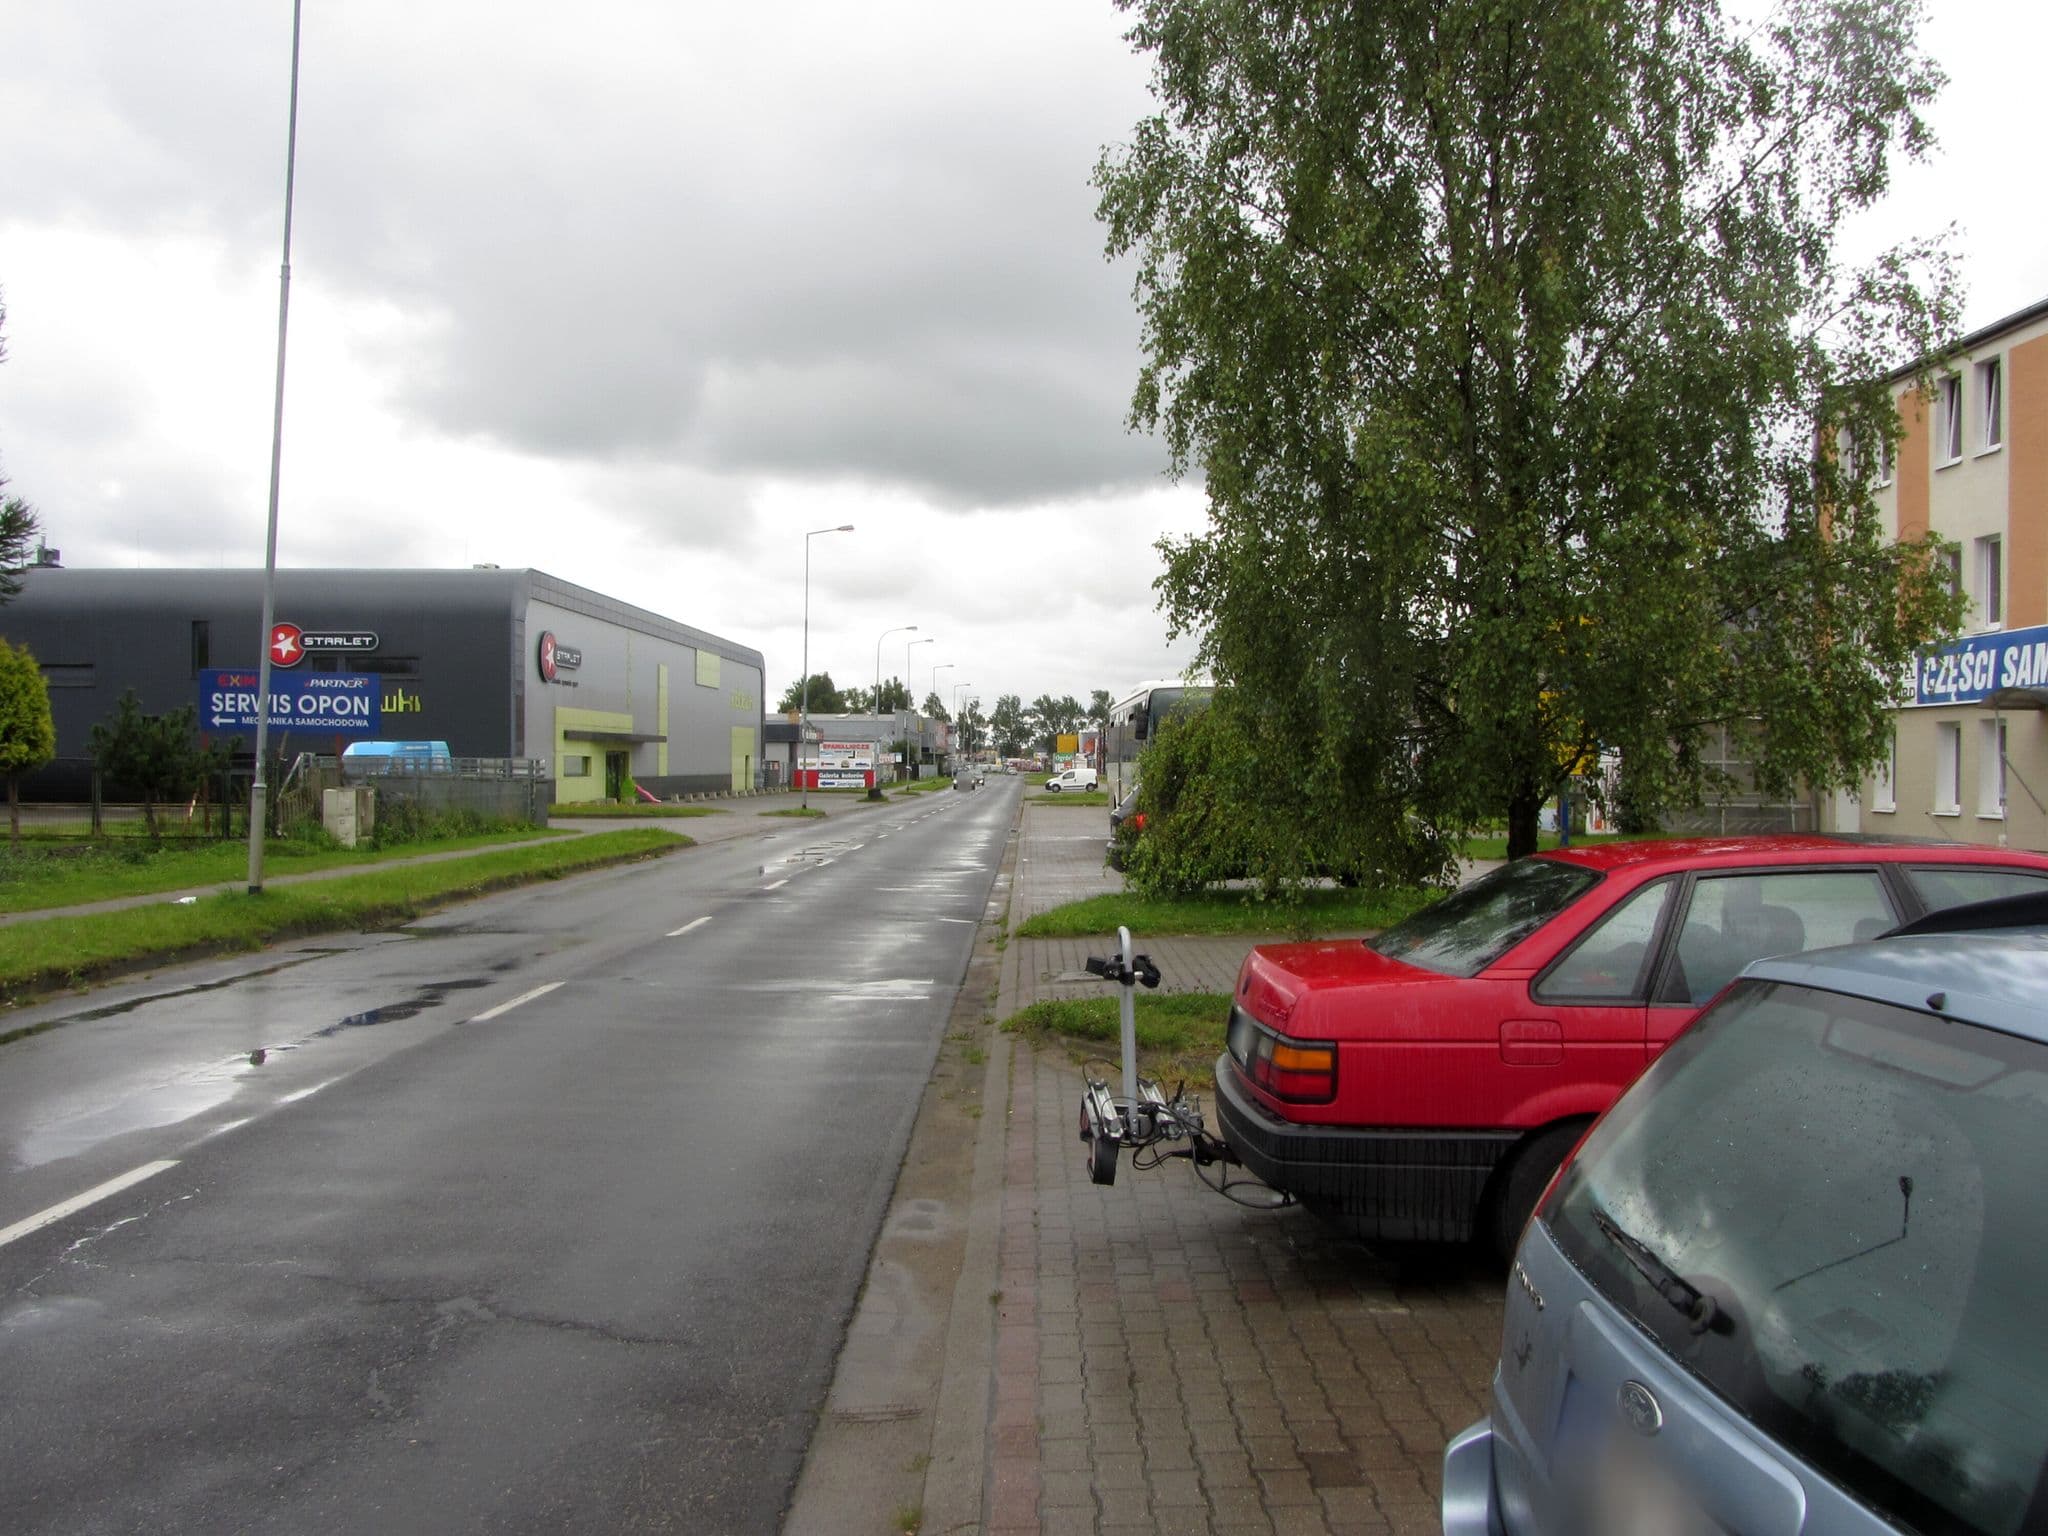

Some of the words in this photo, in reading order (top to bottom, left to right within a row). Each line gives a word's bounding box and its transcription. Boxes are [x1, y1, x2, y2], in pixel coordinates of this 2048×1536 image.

[304, 636, 373, 646] STARLET
[1922, 643, 1996, 702] CZĘŚCI
[310, 678, 364, 688] PARTNER
[298, 694, 369, 716] OPON
[242, 716, 294, 726] MECANIKA
[295, 717, 369, 727] SAMOCHODOWA
